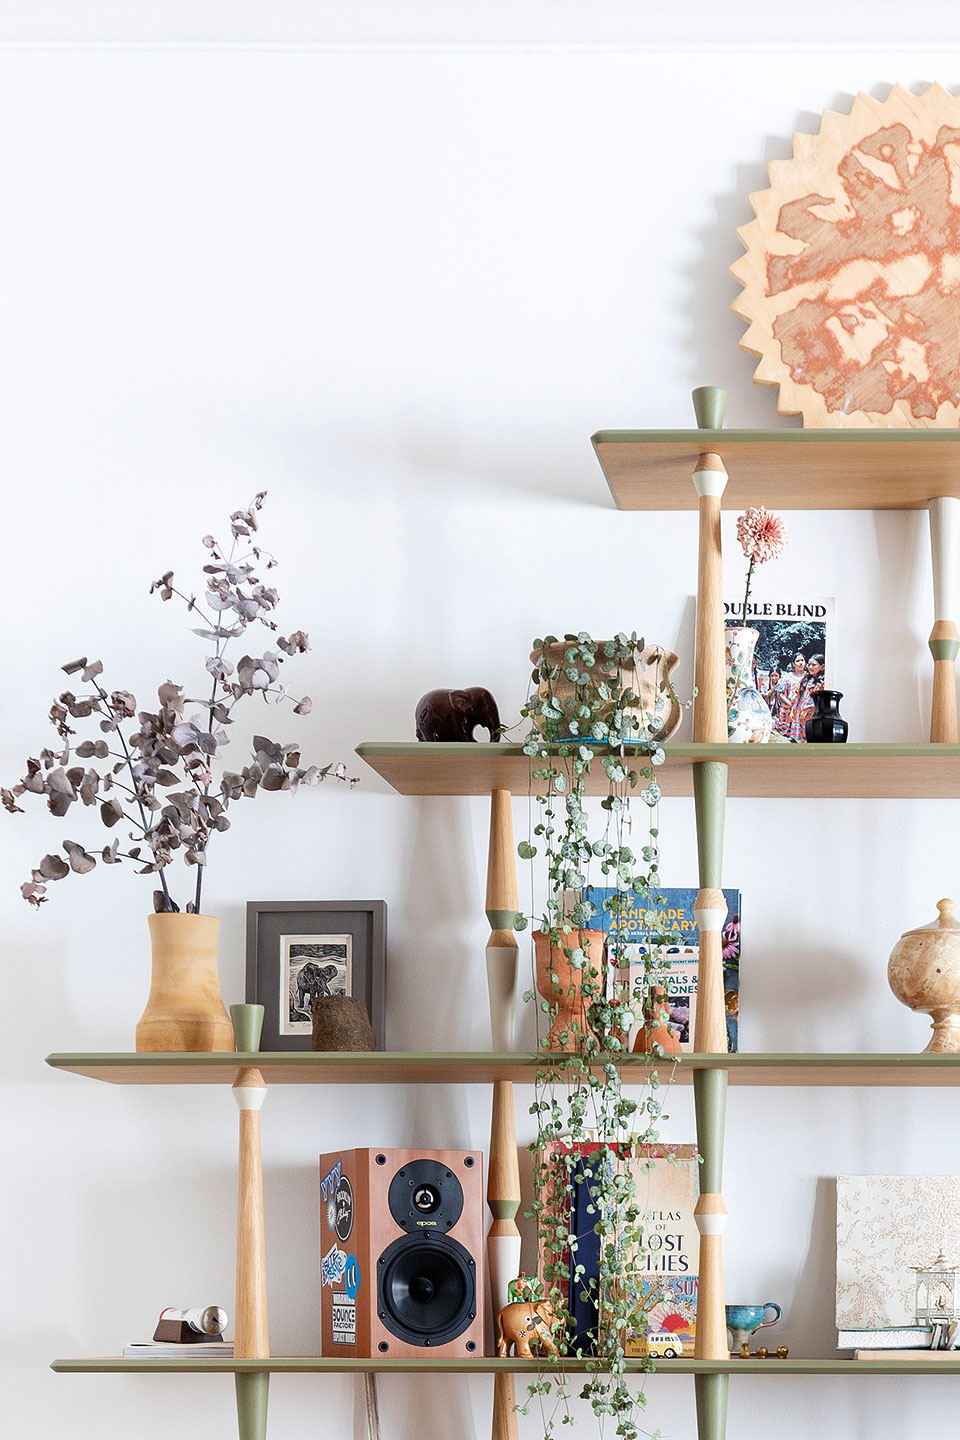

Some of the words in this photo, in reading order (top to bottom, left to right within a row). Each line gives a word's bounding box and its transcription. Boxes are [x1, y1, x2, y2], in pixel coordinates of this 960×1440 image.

[723, 602, 772, 616] OUBLE
[776, 603, 827, 618] BLIND
[655, 1223, 668, 1231] OF
[333, 1308, 355, 1323] BOUNCE
